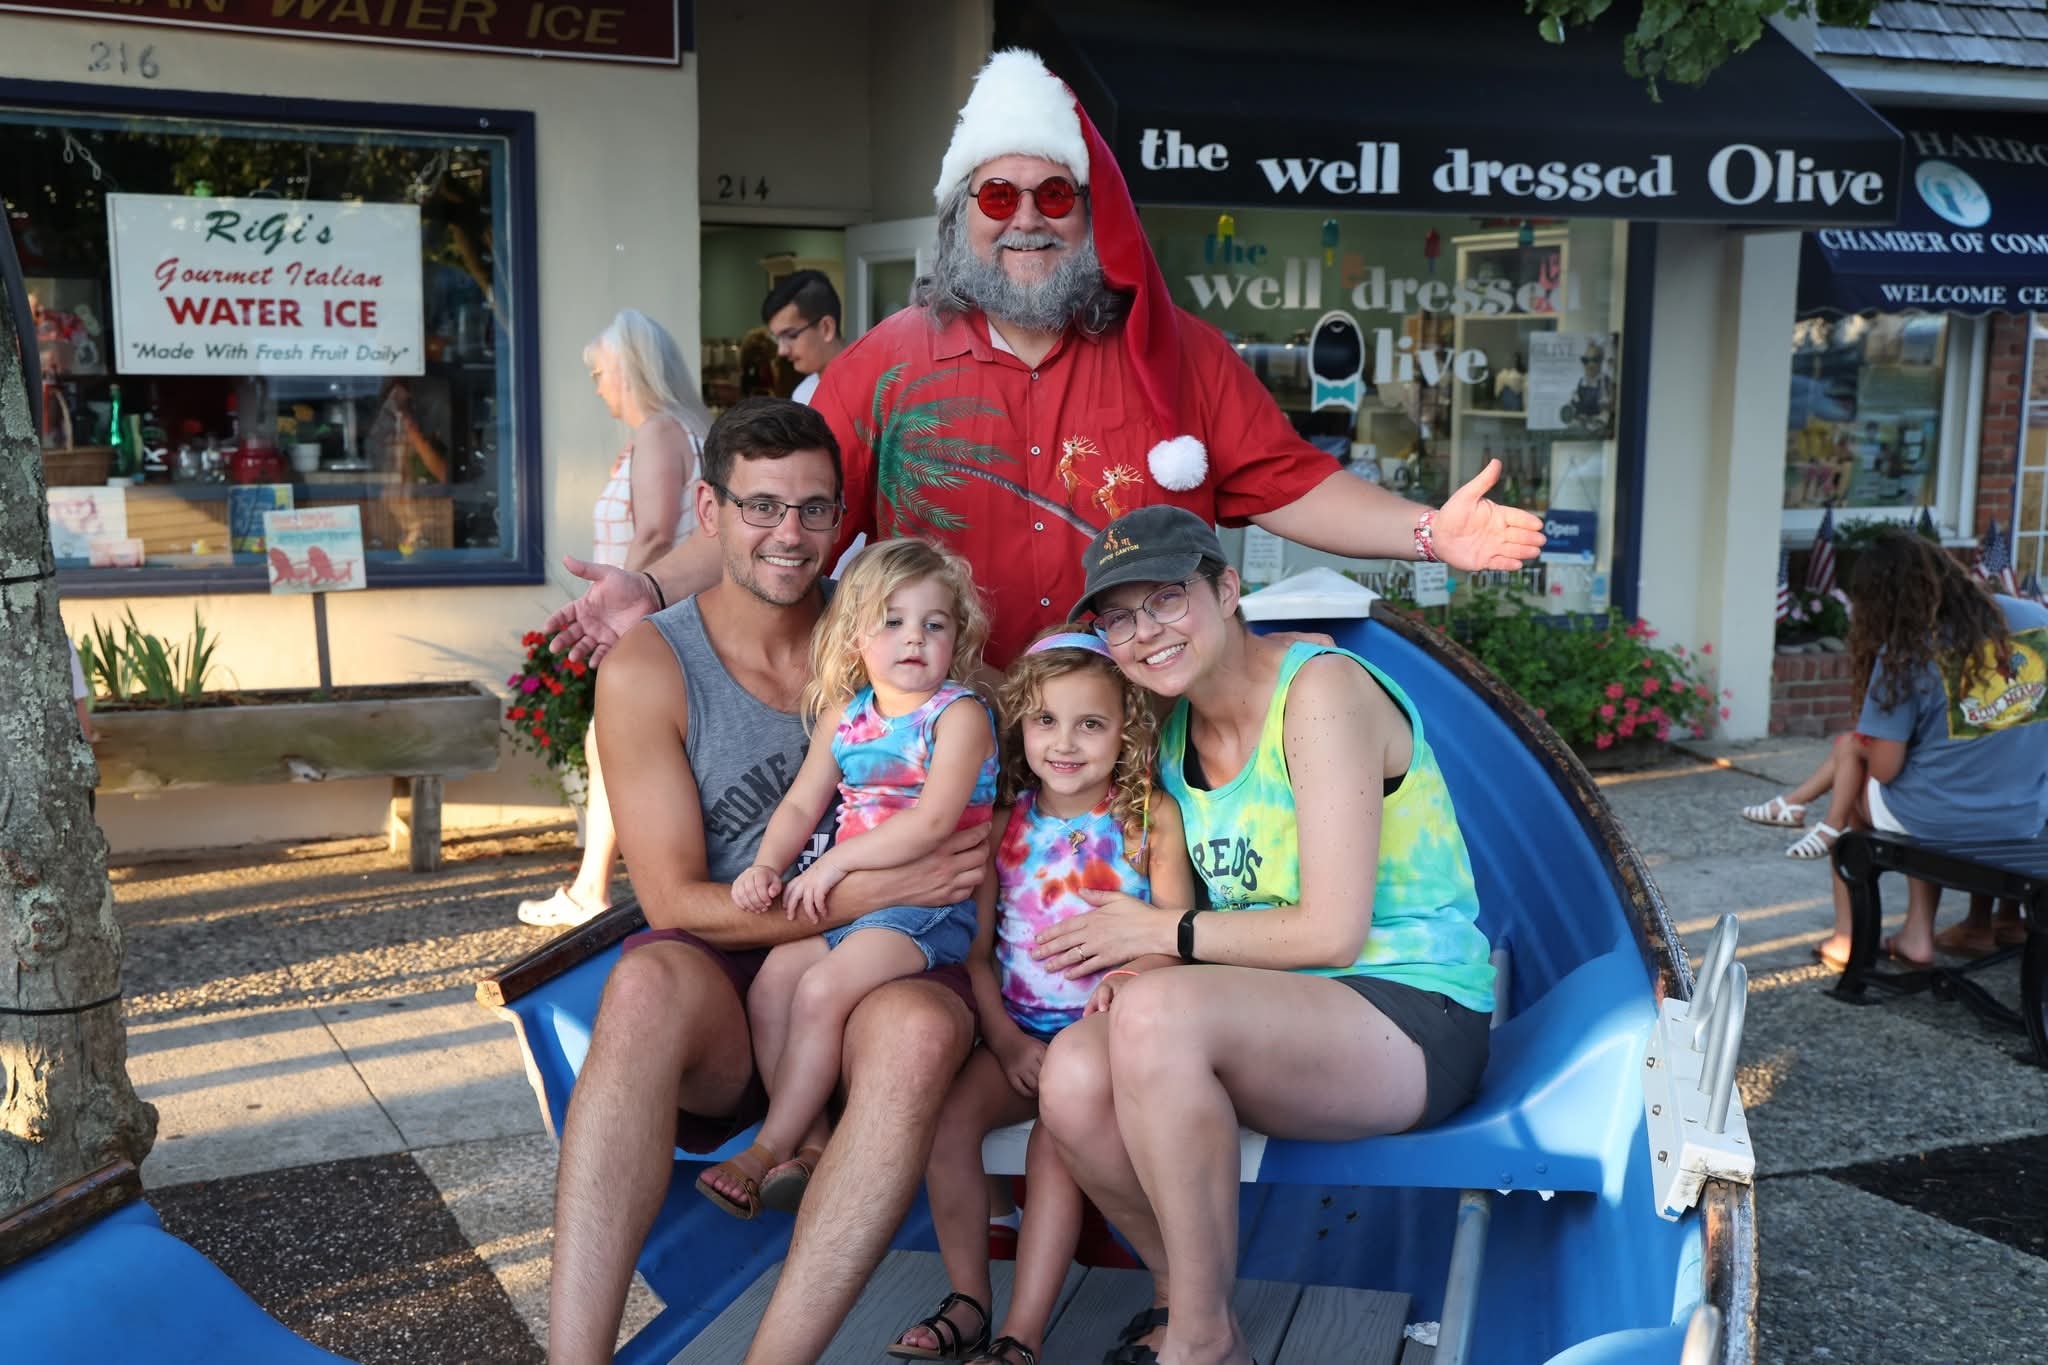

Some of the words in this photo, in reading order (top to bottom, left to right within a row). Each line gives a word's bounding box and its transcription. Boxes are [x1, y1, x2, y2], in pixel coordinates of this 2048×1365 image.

[526, 4, 626, 44] ICE
[88, 41, 160, 79] 216
[1139, 128, 1230, 172] the
[1256, 141, 1400, 195] well
[1432, 148, 1678, 201] dressed
[1707, 142, 1884, 207] Olive
[717, 174, 769, 200] 214
[1204, 233, 1267, 265] the
[1819, 228, 1951, 253] CHAMBER
[1951, 231, 1985, 254] OF
[155, 257, 274, 291] Gourmet
[286, 262, 384, 288] Italian
[1186, 256, 1322, 311] well
[1352, 265, 1582, 316] dressed
[1880, 283, 2007, 304] WELCOME
[165, 297, 303, 327] WATER
[324, 300, 377, 328] ICE
[131, 342, 194, 361] "Made
[205, 343, 248, 360] With
[256, 343, 302, 361] Fresh
[310, 344, 350, 361] Fruit
[1545, 520, 1580, 538] Open
[707, 752, 794, 841] STONE
